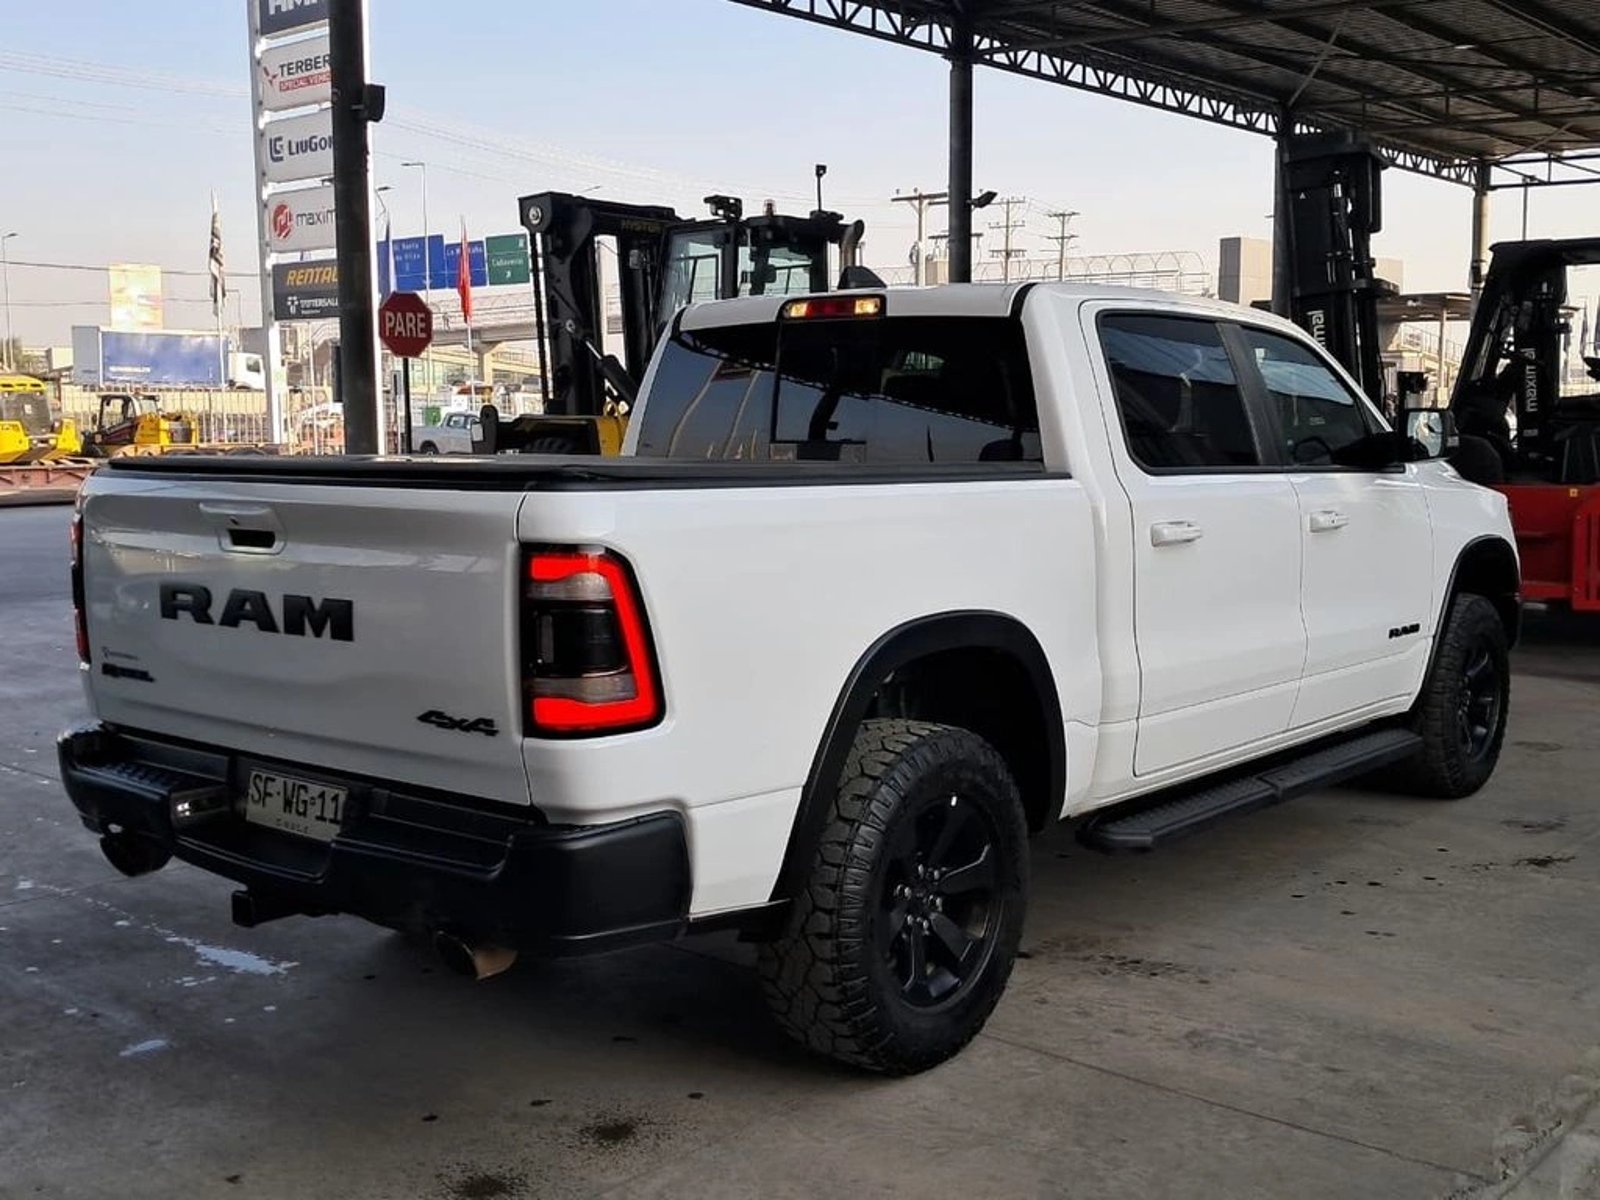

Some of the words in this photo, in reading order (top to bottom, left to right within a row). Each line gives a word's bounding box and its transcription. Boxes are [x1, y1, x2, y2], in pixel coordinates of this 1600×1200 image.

[385, 311, 426, 338] PARE
[159, 583, 354, 642] RAM
[1388, 623, 1420, 639] RAM
